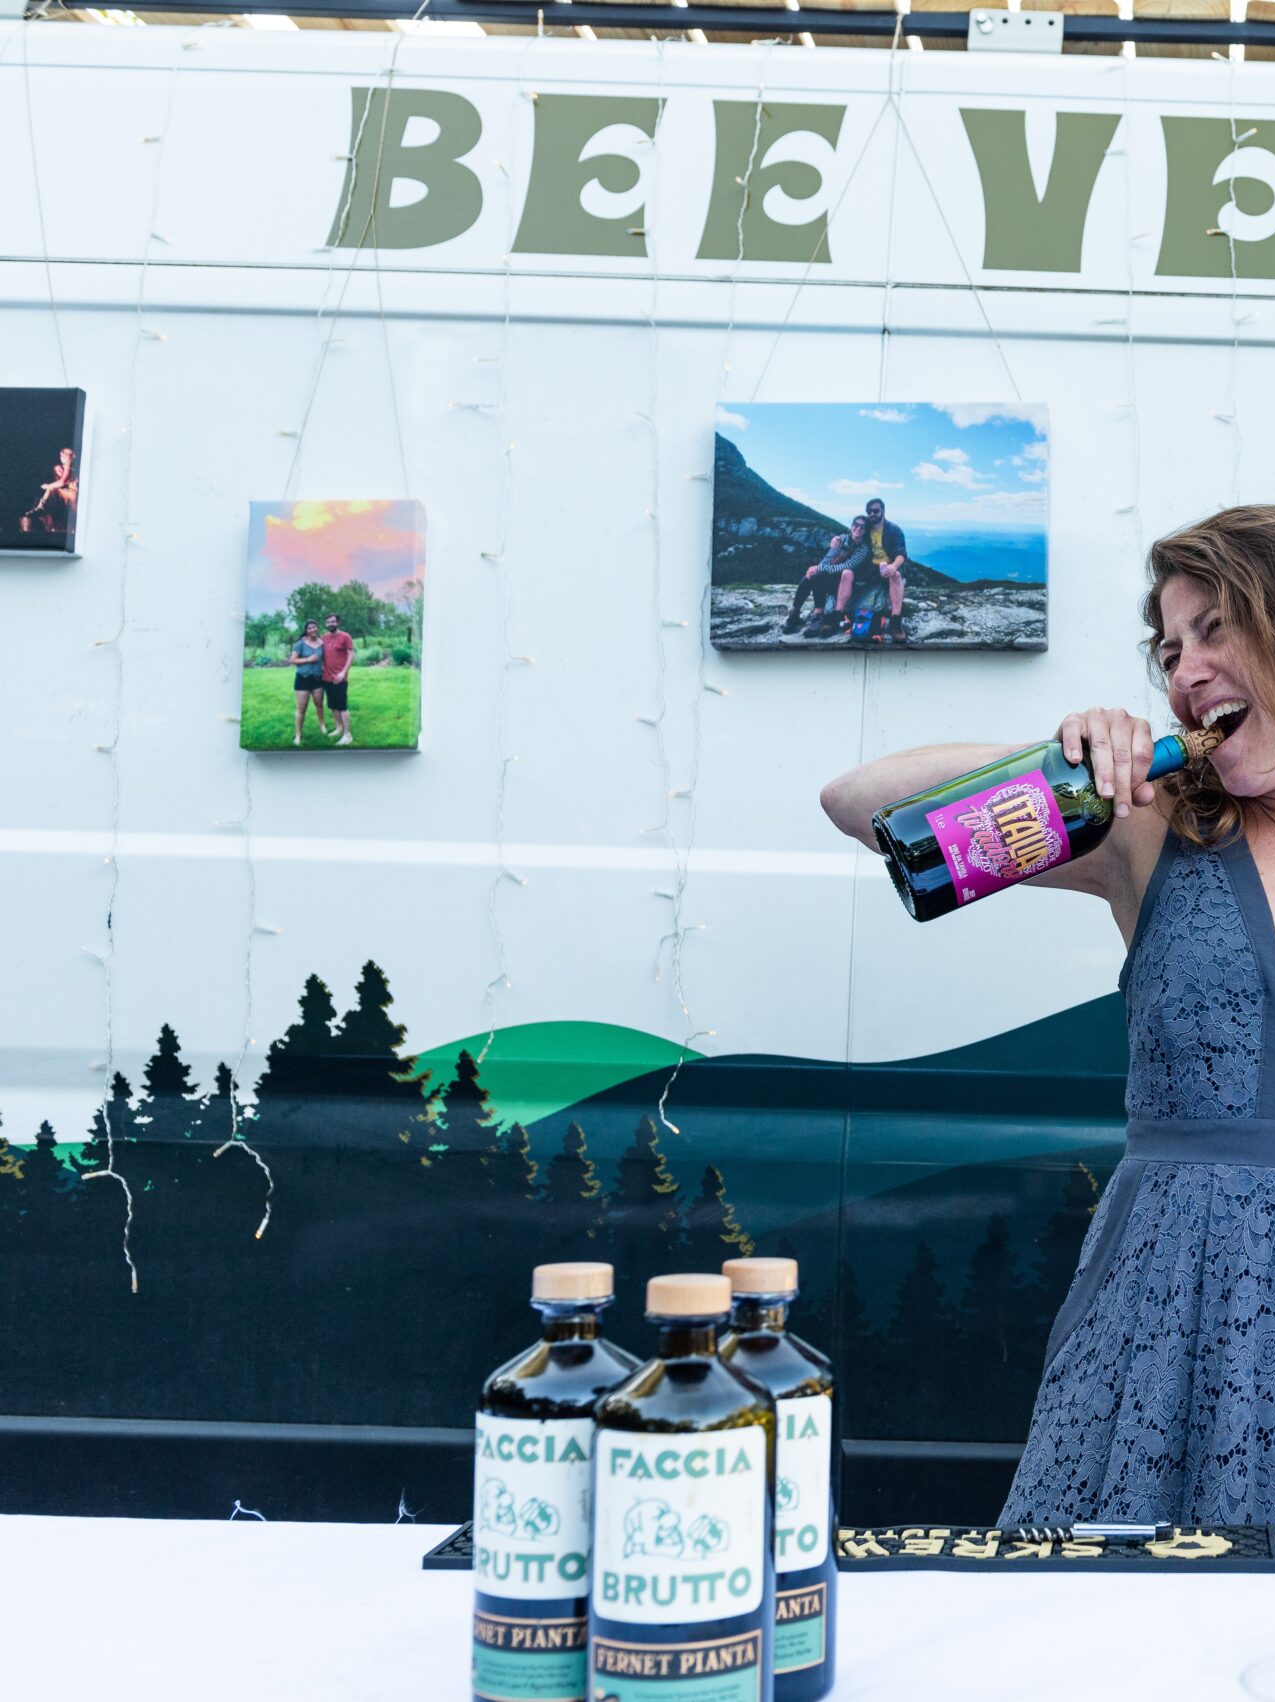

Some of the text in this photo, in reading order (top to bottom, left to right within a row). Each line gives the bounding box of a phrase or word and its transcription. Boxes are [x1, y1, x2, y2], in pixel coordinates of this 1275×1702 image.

[327, 86, 848, 264] BEE
[991, 793, 1047, 871] ITALIA
[610, 1447, 752, 1480] FACCIA
[477, 1547, 587, 1583] RUTTO
[602, 1566, 753, 1607] BRUTTO
[775, 1593, 821, 1621] ANTA
[596, 1647, 673, 1676] FERNET
[679, 1641, 756, 1675] PIANTA
